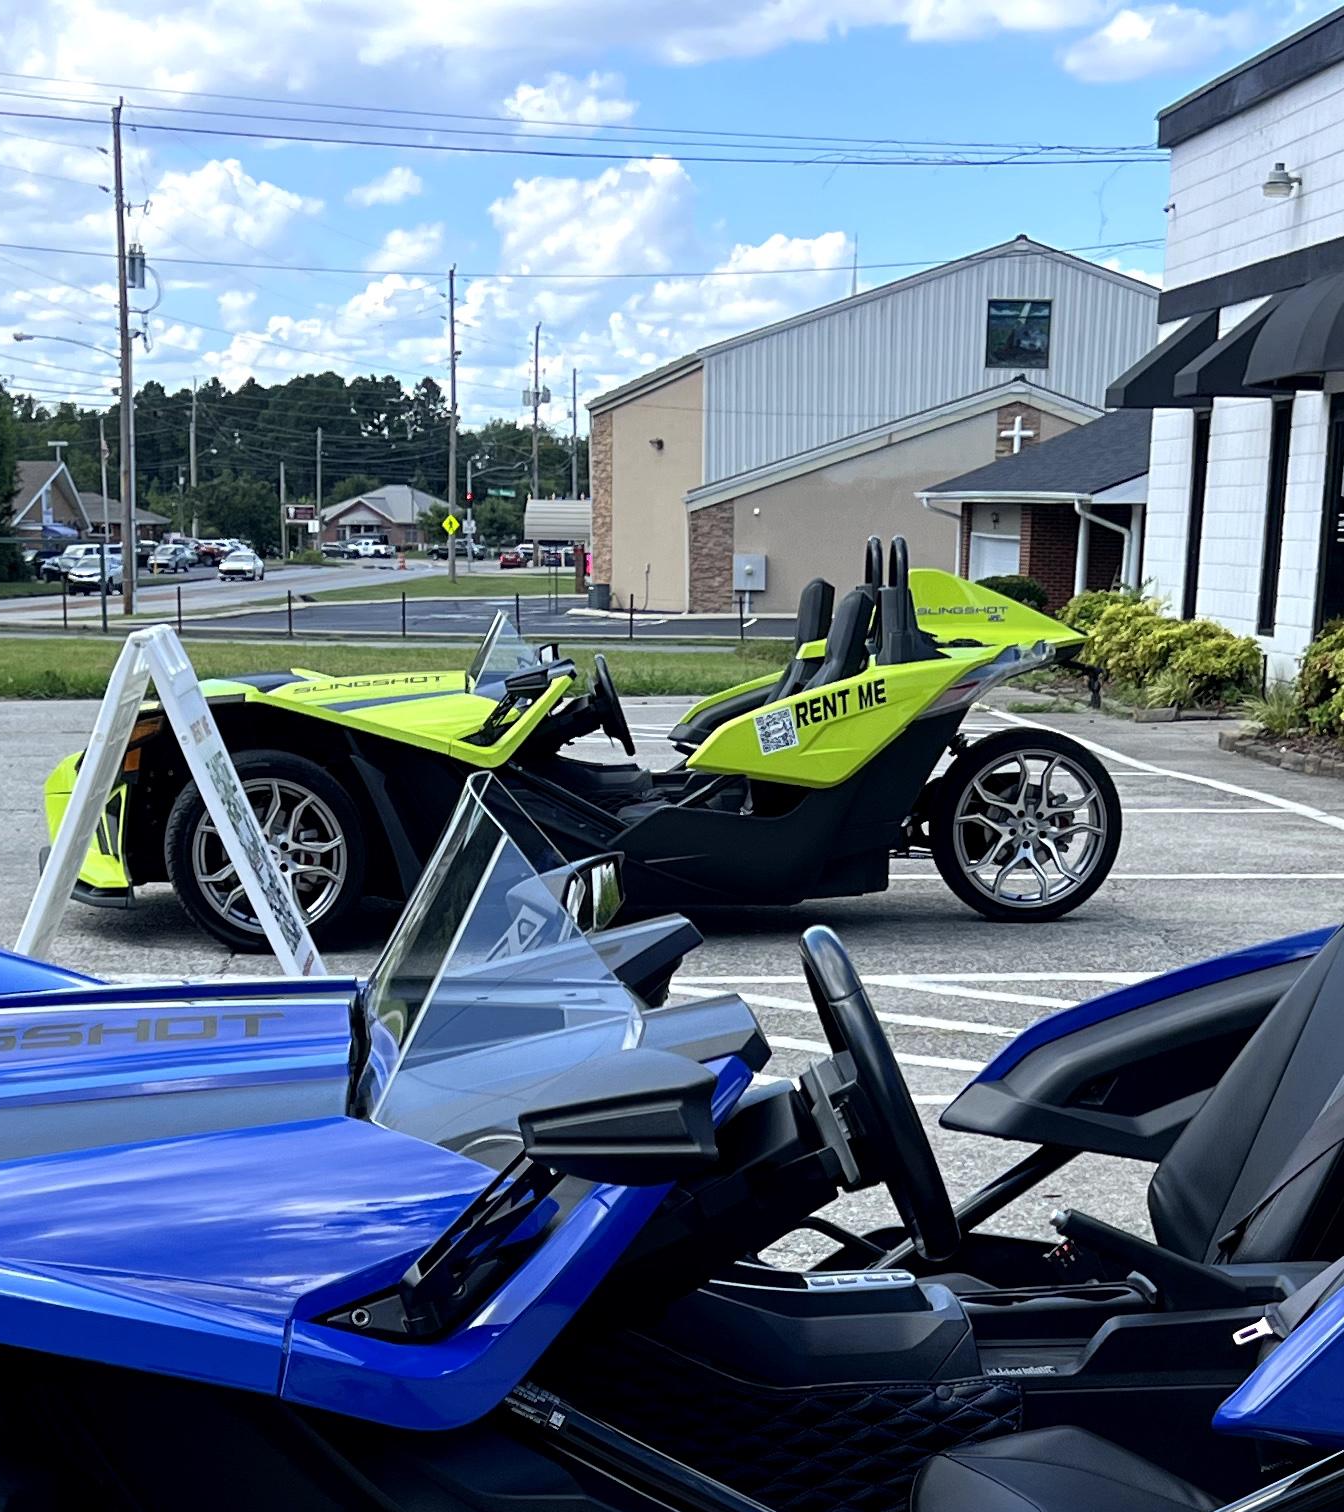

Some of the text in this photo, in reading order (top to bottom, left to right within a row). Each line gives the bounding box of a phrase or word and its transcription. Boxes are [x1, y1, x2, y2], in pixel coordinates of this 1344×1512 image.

[917, 605, 1008, 616] SLINGSHOT
[293, 674, 448, 695] SLINGSHOT
[795, 688, 850, 728] RENT
[858, 679, 887, 710] ME
